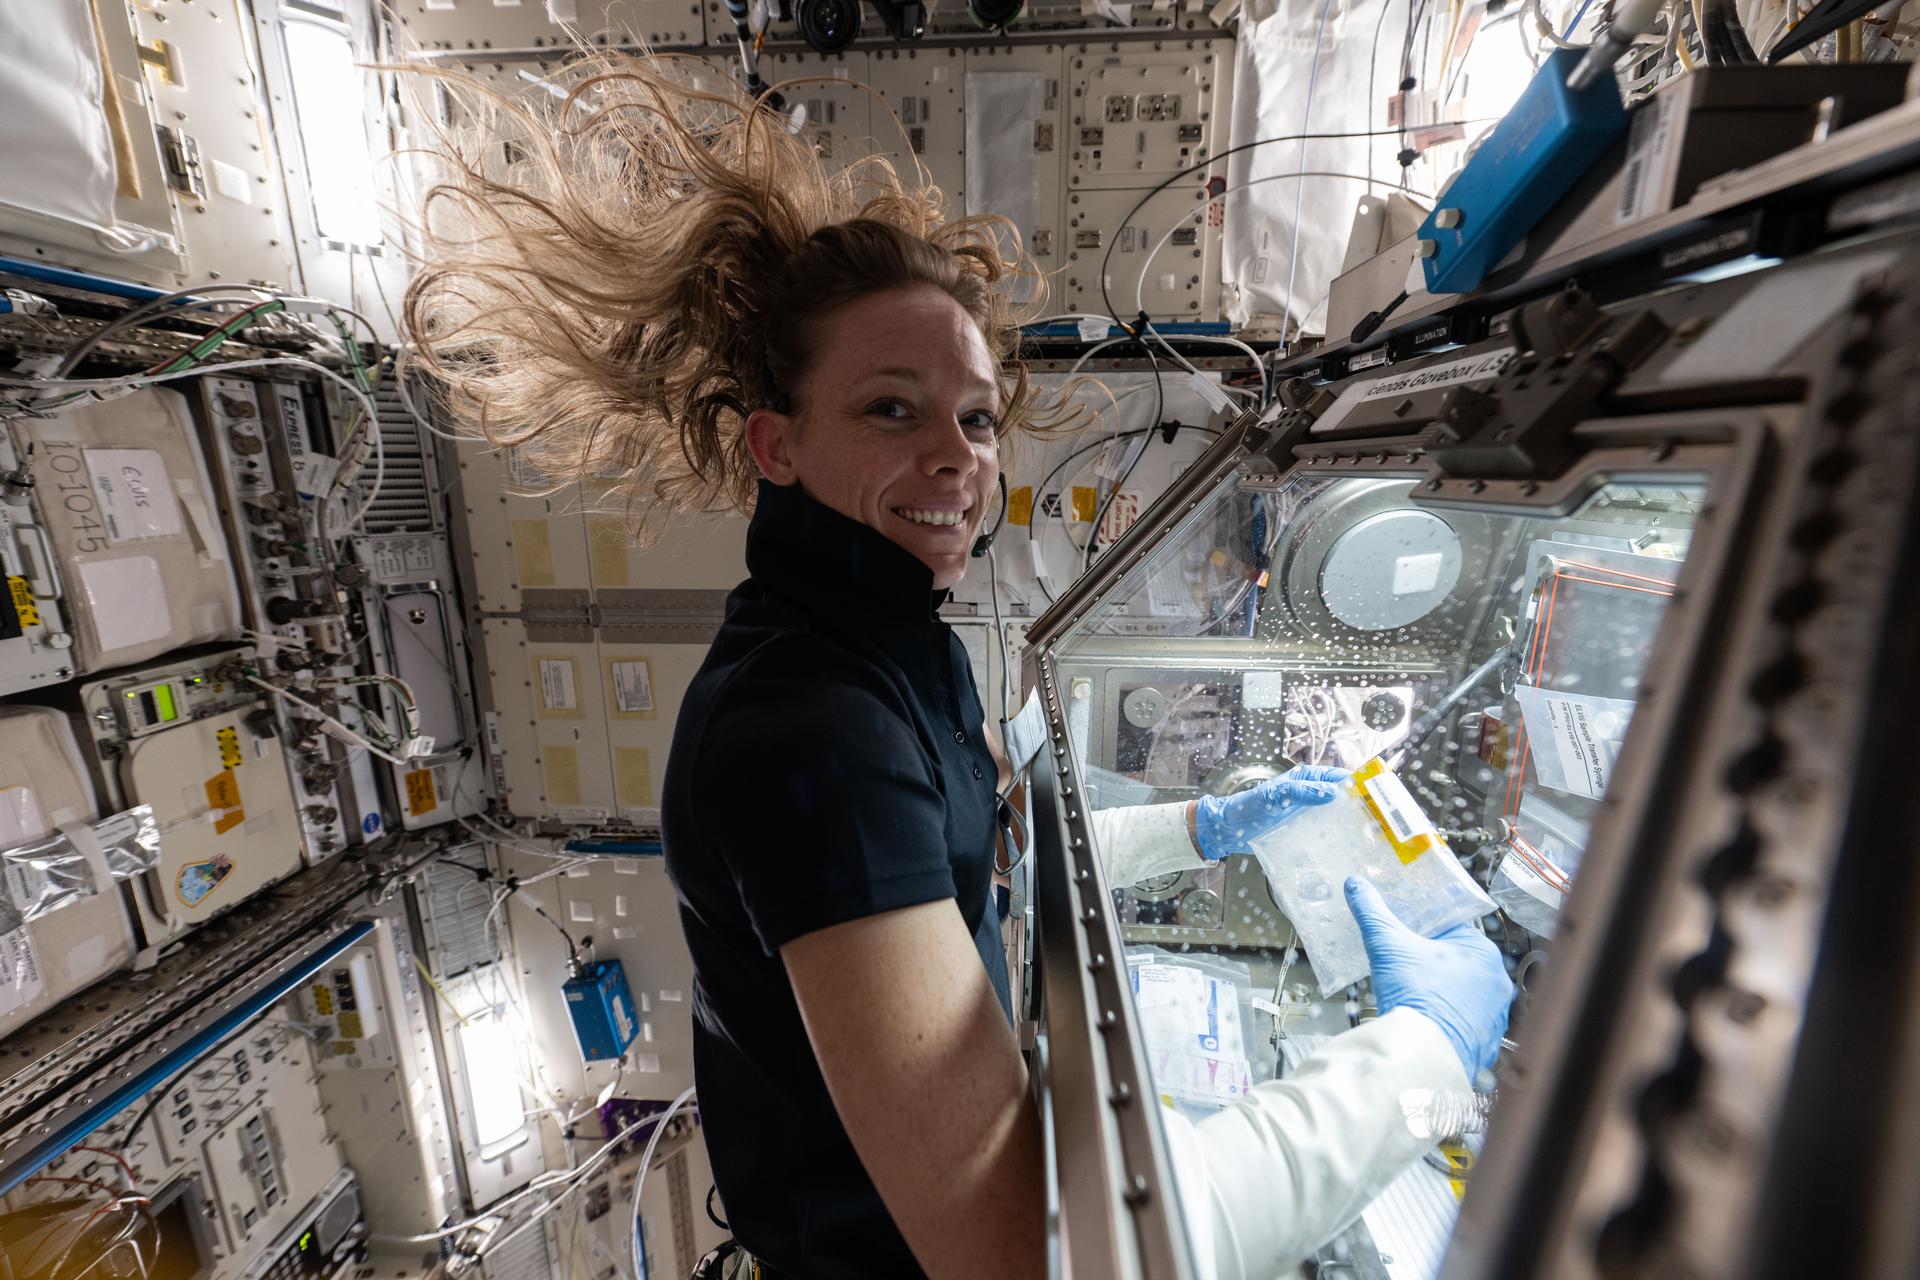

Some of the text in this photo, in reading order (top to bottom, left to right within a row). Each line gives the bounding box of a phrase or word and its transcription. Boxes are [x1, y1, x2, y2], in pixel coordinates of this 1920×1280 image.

[1415, 326, 1447, 344] ILLUMINATION
[1411, 365, 1471, 387] Glovebox
[281, 395, 304, 456] EXPRESS
[120, 466, 151, 507] ELVIS
[1574, 703, 1604, 788] ELVIS Sample Transfer Syringe
